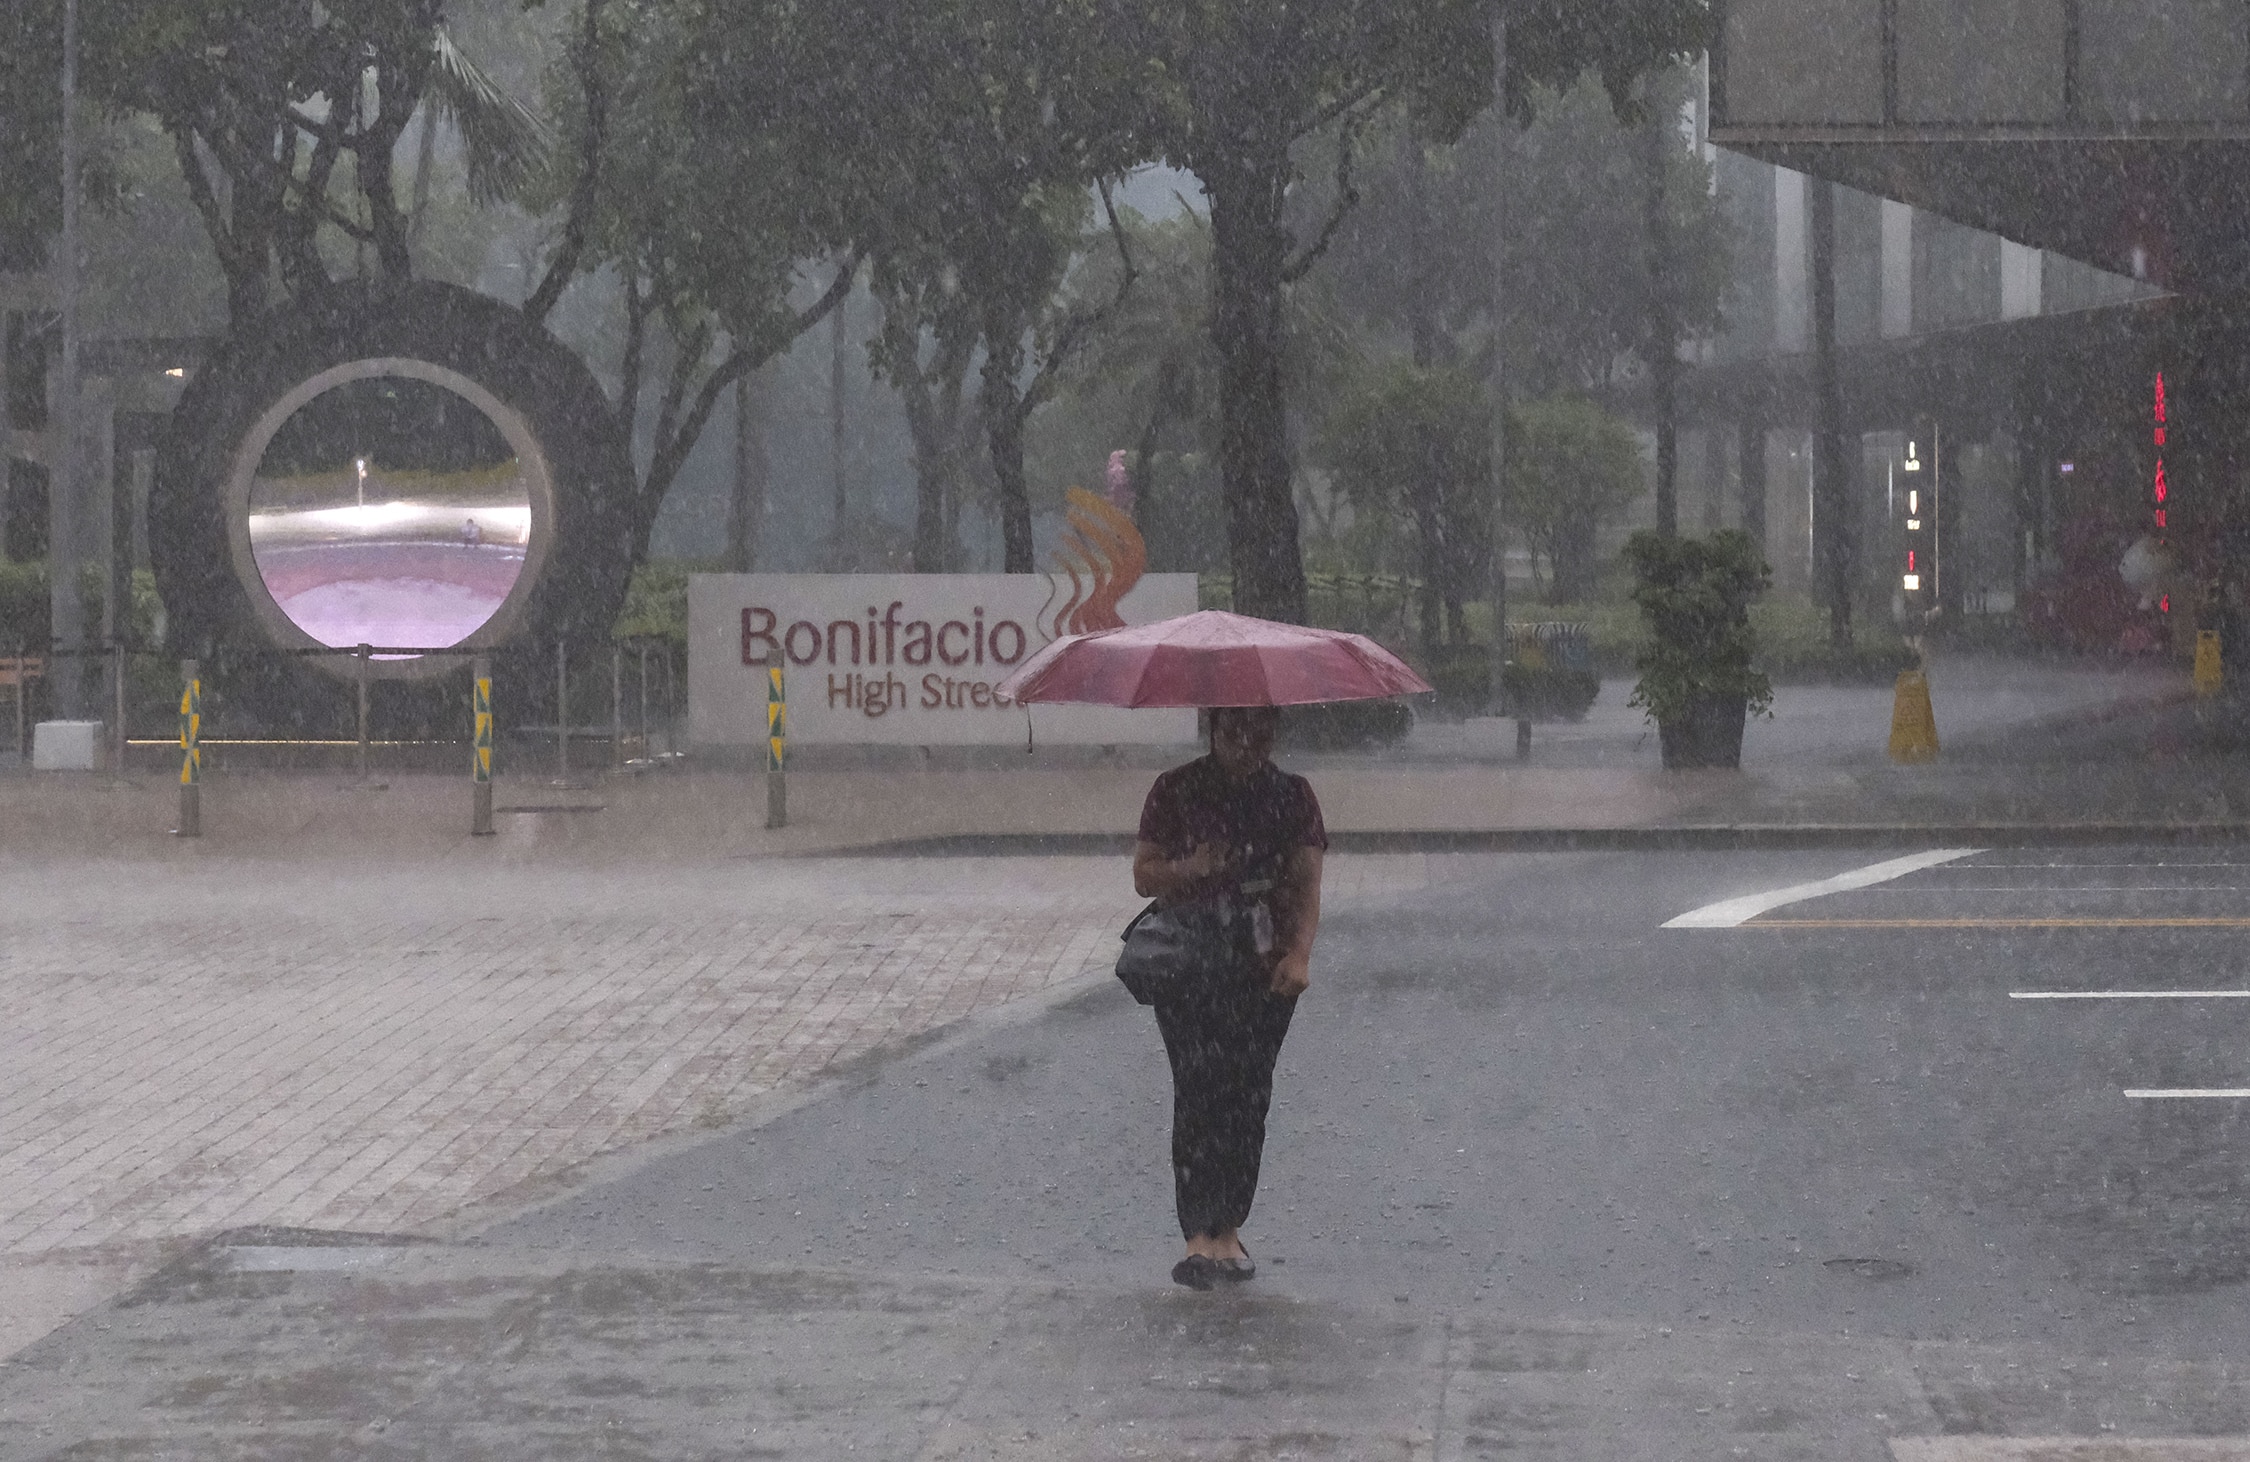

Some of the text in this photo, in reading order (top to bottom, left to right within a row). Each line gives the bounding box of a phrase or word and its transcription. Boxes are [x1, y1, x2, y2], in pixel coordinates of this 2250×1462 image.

[740, 601, 1027, 666] Bonifacio
[827, 671, 1025, 717] High Stree
